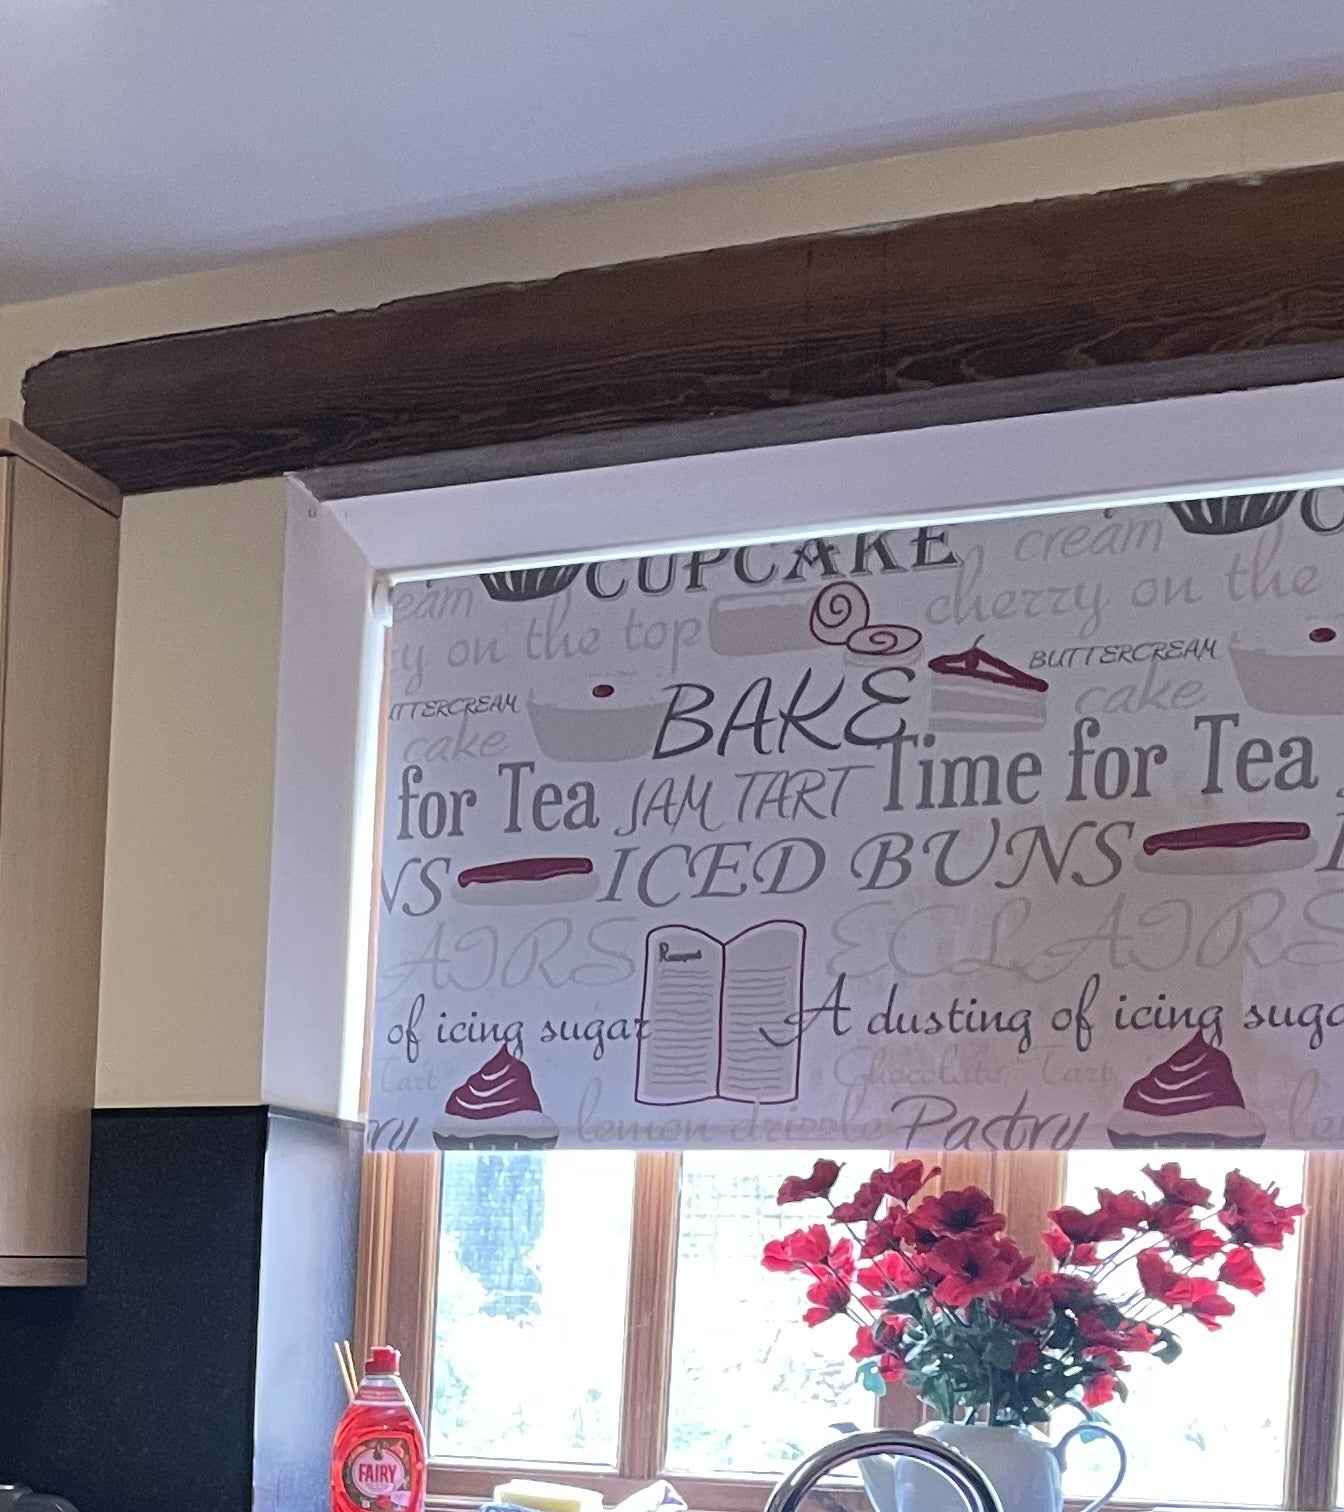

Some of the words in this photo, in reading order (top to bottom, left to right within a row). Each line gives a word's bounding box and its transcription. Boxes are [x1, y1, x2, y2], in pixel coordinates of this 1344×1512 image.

[586, 525, 963, 602] CUPCAKE
[1014, 516, 1163, 562] cream
[925, 544, 1108, 639] cherry
[1131, 573, 1203, 608] on
[1225, 522, 1320, 600] the
[446, 637, 508, 668] on
[527, 588, 600, 660] the
[625, 608, 701, 674] top
[1028, 637, 1219, 669] BUTTERCREAM
[652, 666, 917, 760] BAKE
[1075, 661, 1206, 716] cake
[403, 708, 509, 762] cake
[877, 734, 1043, 812] Time
[1066, 717, 1167, 801] for
[1194, 713, 1319, 795] Tea
[396, 764, 477, 840] for
[498, 761, 600, 834] Tea
[614, 774, 724, 836] JAM
[734, 765, 876, 824] TART
[596, 837, 826, 908] ICED
[850, 817, 1136, 890] BUNS
[387, 993, 426, 1063] of
[437, 1011, 524, 1061] icing
[540, 1017, 654, 1061] sugar
[759, 972, 853, 1047] A
[867, 983, 1032, 1053] dusting
[1052, 973, 1101, 1052] of
[1115, 993, 1223, 1050] icing
[577, 1076, 714, 1143] lemon
[730, 1076, 888, 1144] drizzle
[889, 1089, 1091, 1150] Pastry
[358, 1463, 397, 1484] FAIRY
